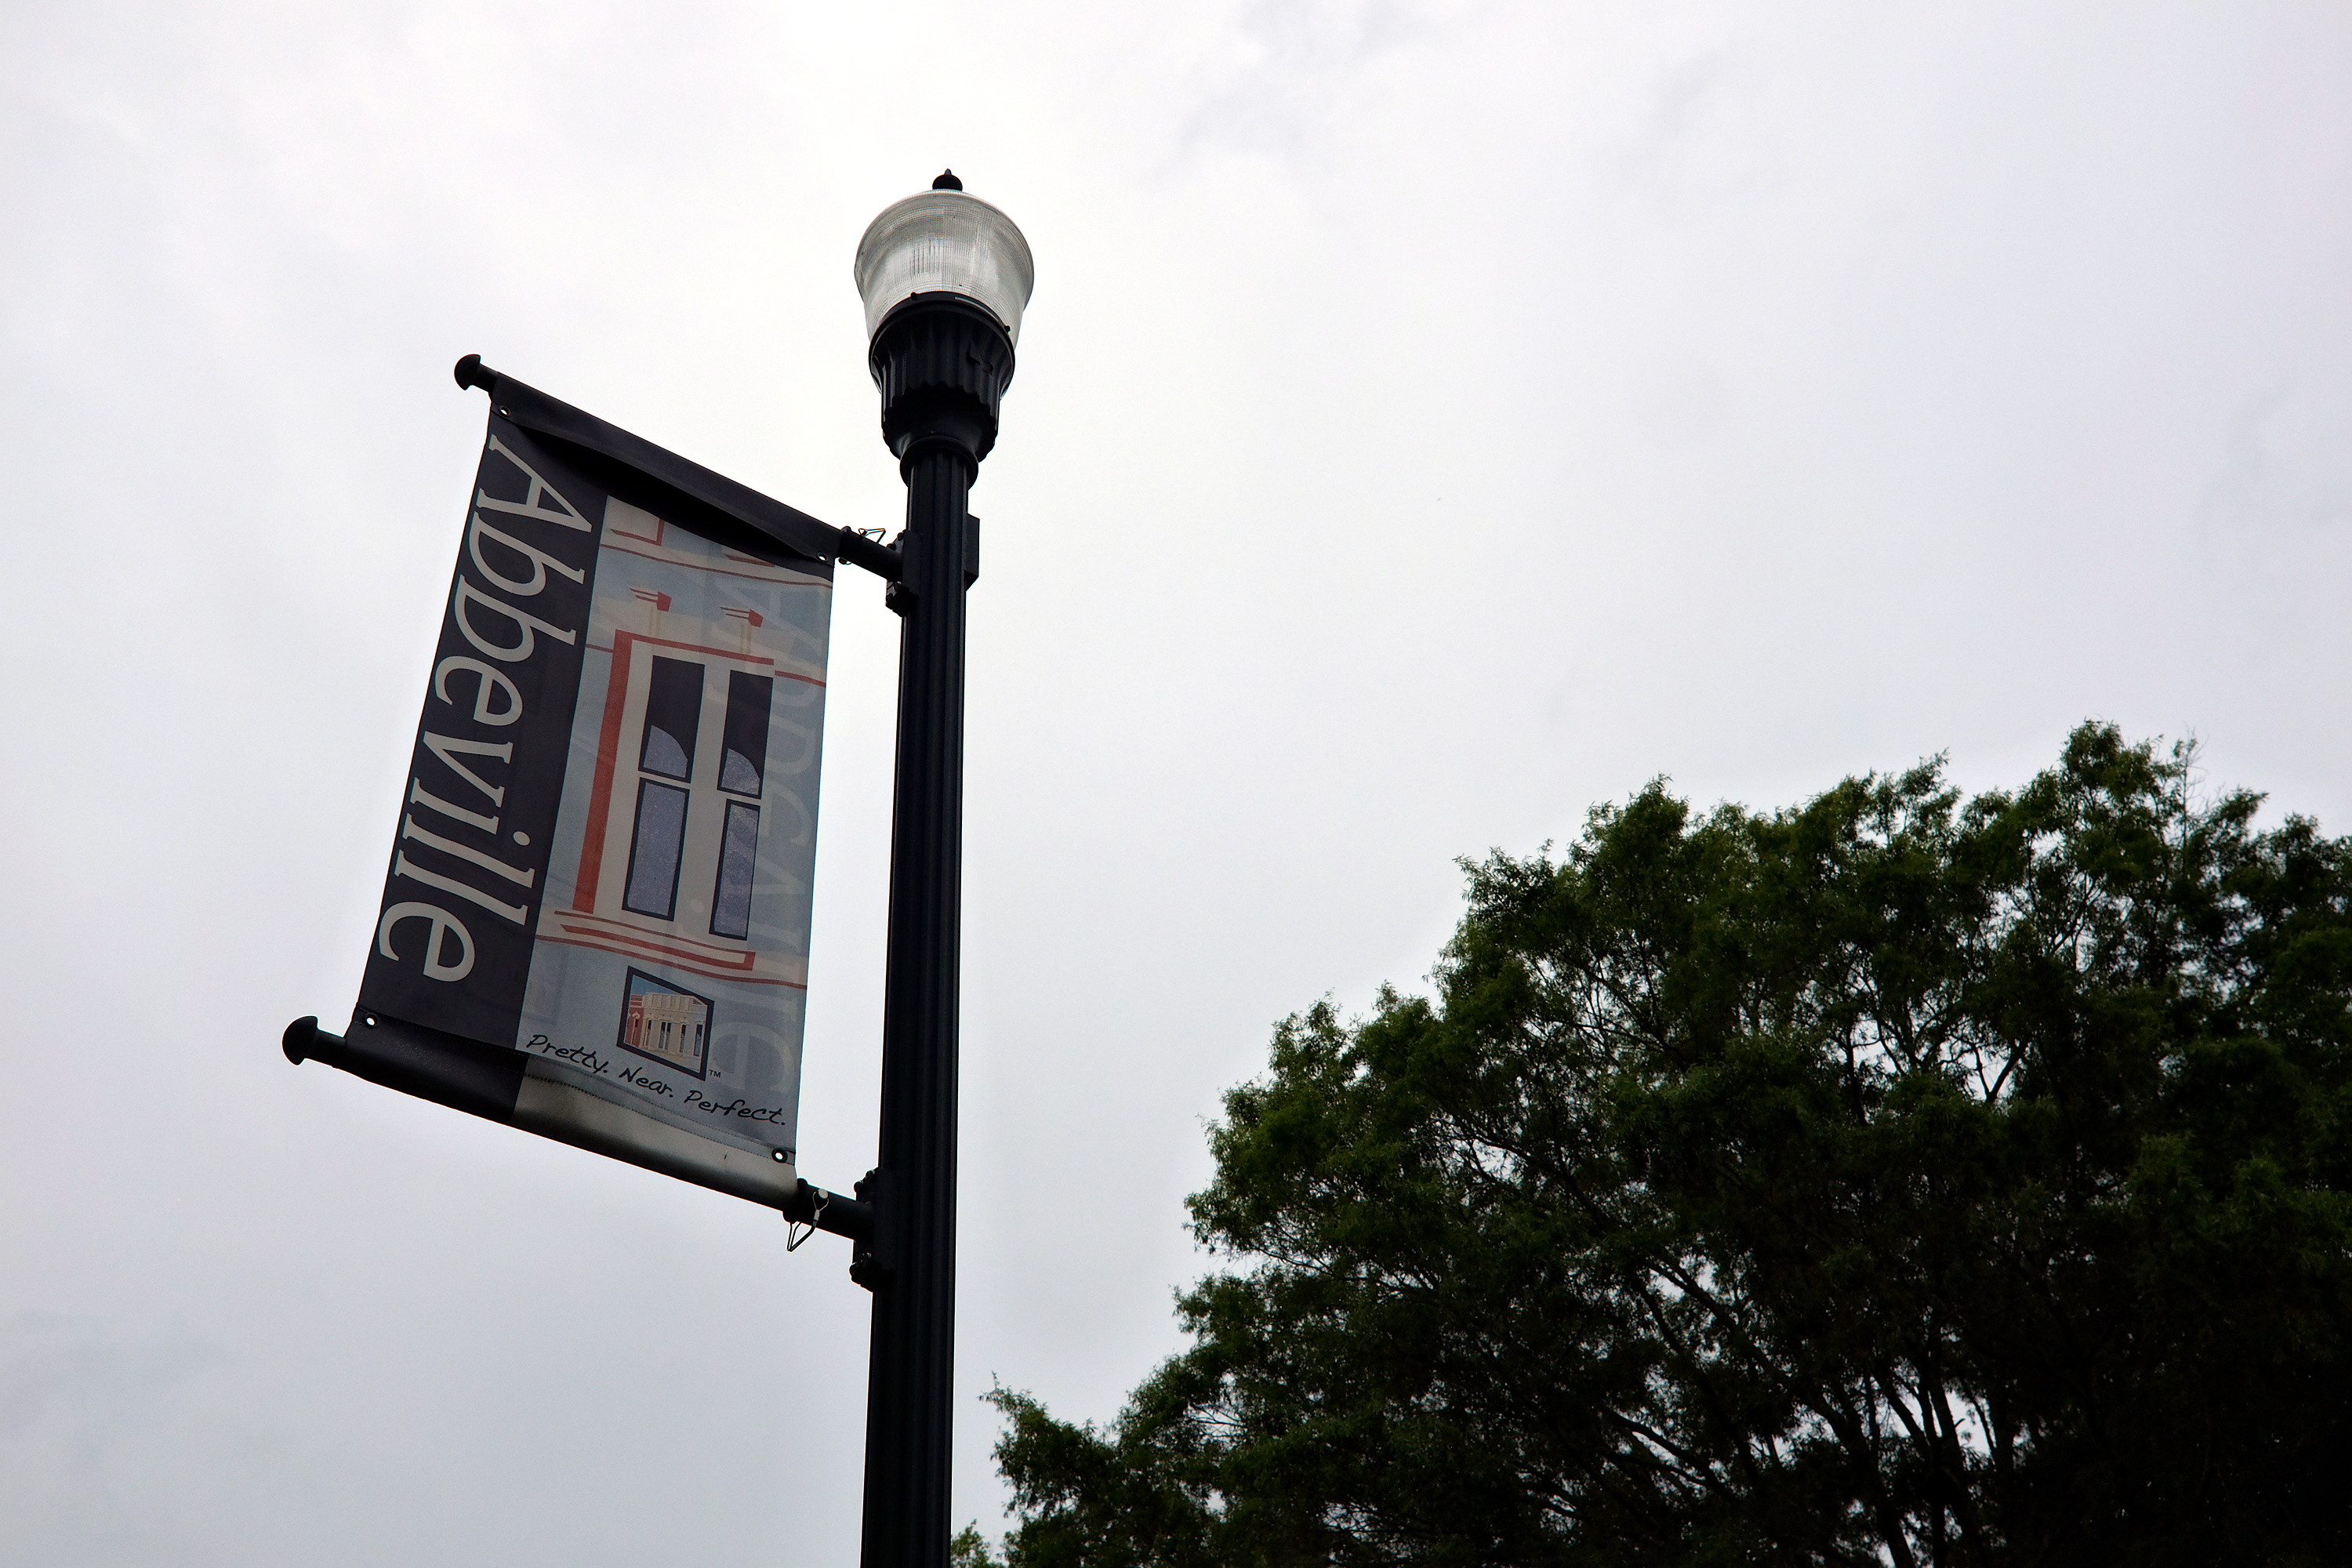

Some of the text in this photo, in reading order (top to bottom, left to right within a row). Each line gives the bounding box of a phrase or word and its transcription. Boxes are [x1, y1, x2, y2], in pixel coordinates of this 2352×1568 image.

[378, 433, 593, 982] Abbeville
[526, 1033, 786, 1126] Pretty. Near. Perfect.
